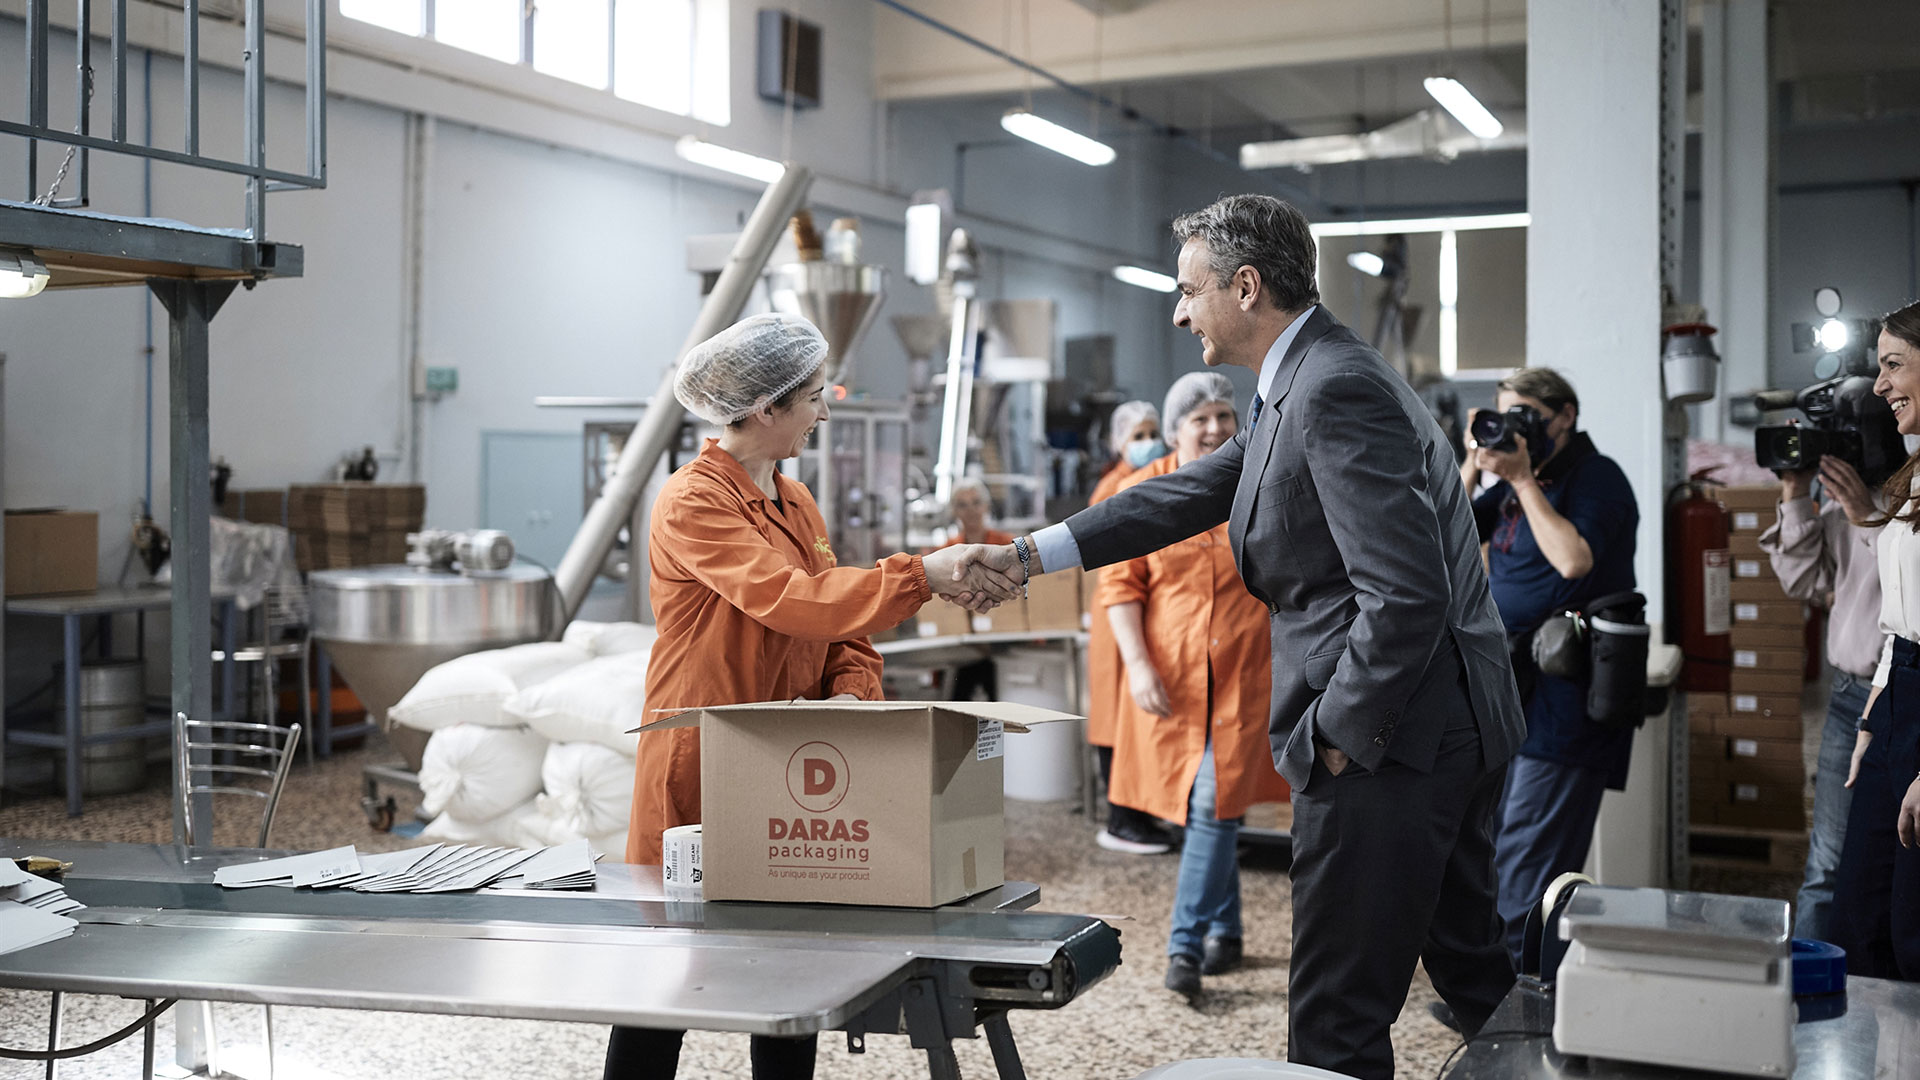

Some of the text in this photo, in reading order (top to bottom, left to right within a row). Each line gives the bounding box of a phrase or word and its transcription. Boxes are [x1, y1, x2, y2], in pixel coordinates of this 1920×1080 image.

[803, 758, 837, 796] D
[768, 817, 870, 843] DARAS
[768, 843, 870, 863] packaging
[767, 868, 778, 878] As
[780, 870, 807, 880] unique
[820, 872, 838, 881] your
[839, 872, 871, 881] product
